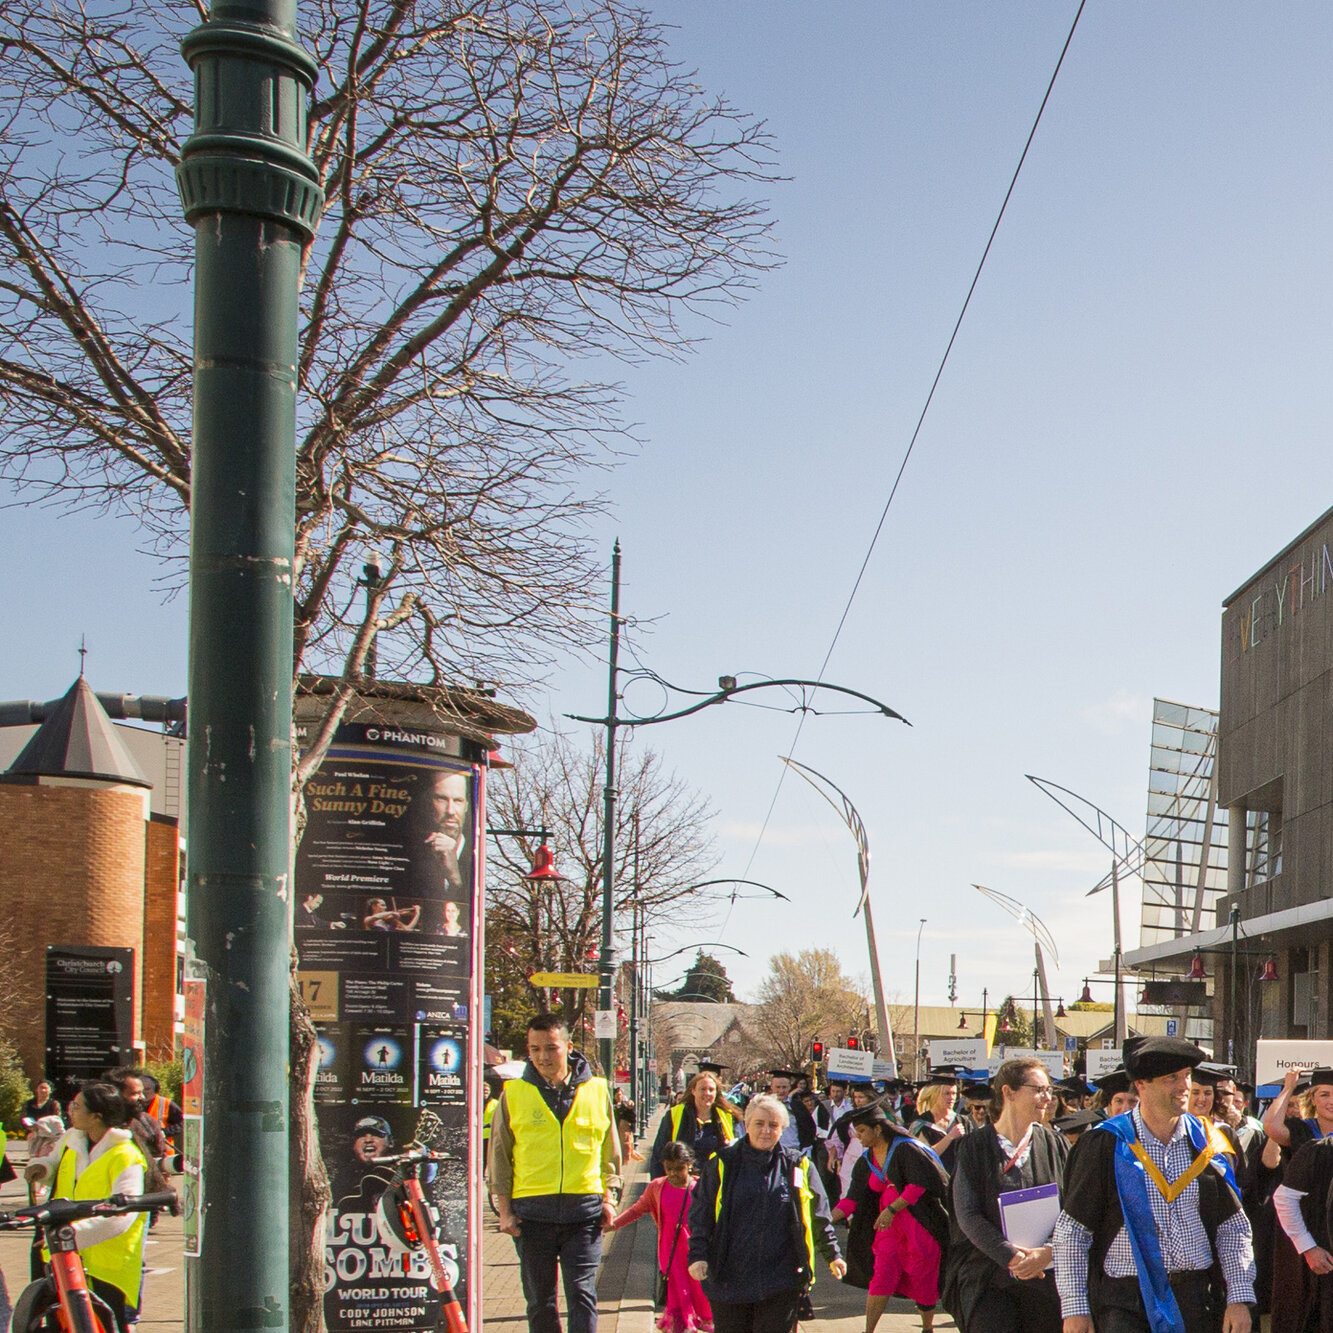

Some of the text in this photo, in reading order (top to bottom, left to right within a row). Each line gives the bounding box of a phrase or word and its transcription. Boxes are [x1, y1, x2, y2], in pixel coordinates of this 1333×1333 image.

[382, 729, 447, 748] PHANTOM
[306, 782, 412, 802] Such A Fine,
[312, 798, 407, 818] Sunny Day
[324, 873, 390, 883] World Premiere
[57, 959, 105, 967] Christchurch
[64, 966, 78, 974] City
[299, 981, 323, 1001] 17
[426, 1011, 451, 1019] ANZCA
[1276, 1059, 1320, 1068] Honours
[315, 1072, 338, 1083] tilda
[361, 1071, 404, 1084] Matilda
[428, 1073, 461, 1086] Matilda
[337, 1286, 429, 1300] WORLD TOUR
[339, 1307, 426, 1318] CODY JOHNSON
[350, 1318, 415, 1327] LANE PITTMAN
